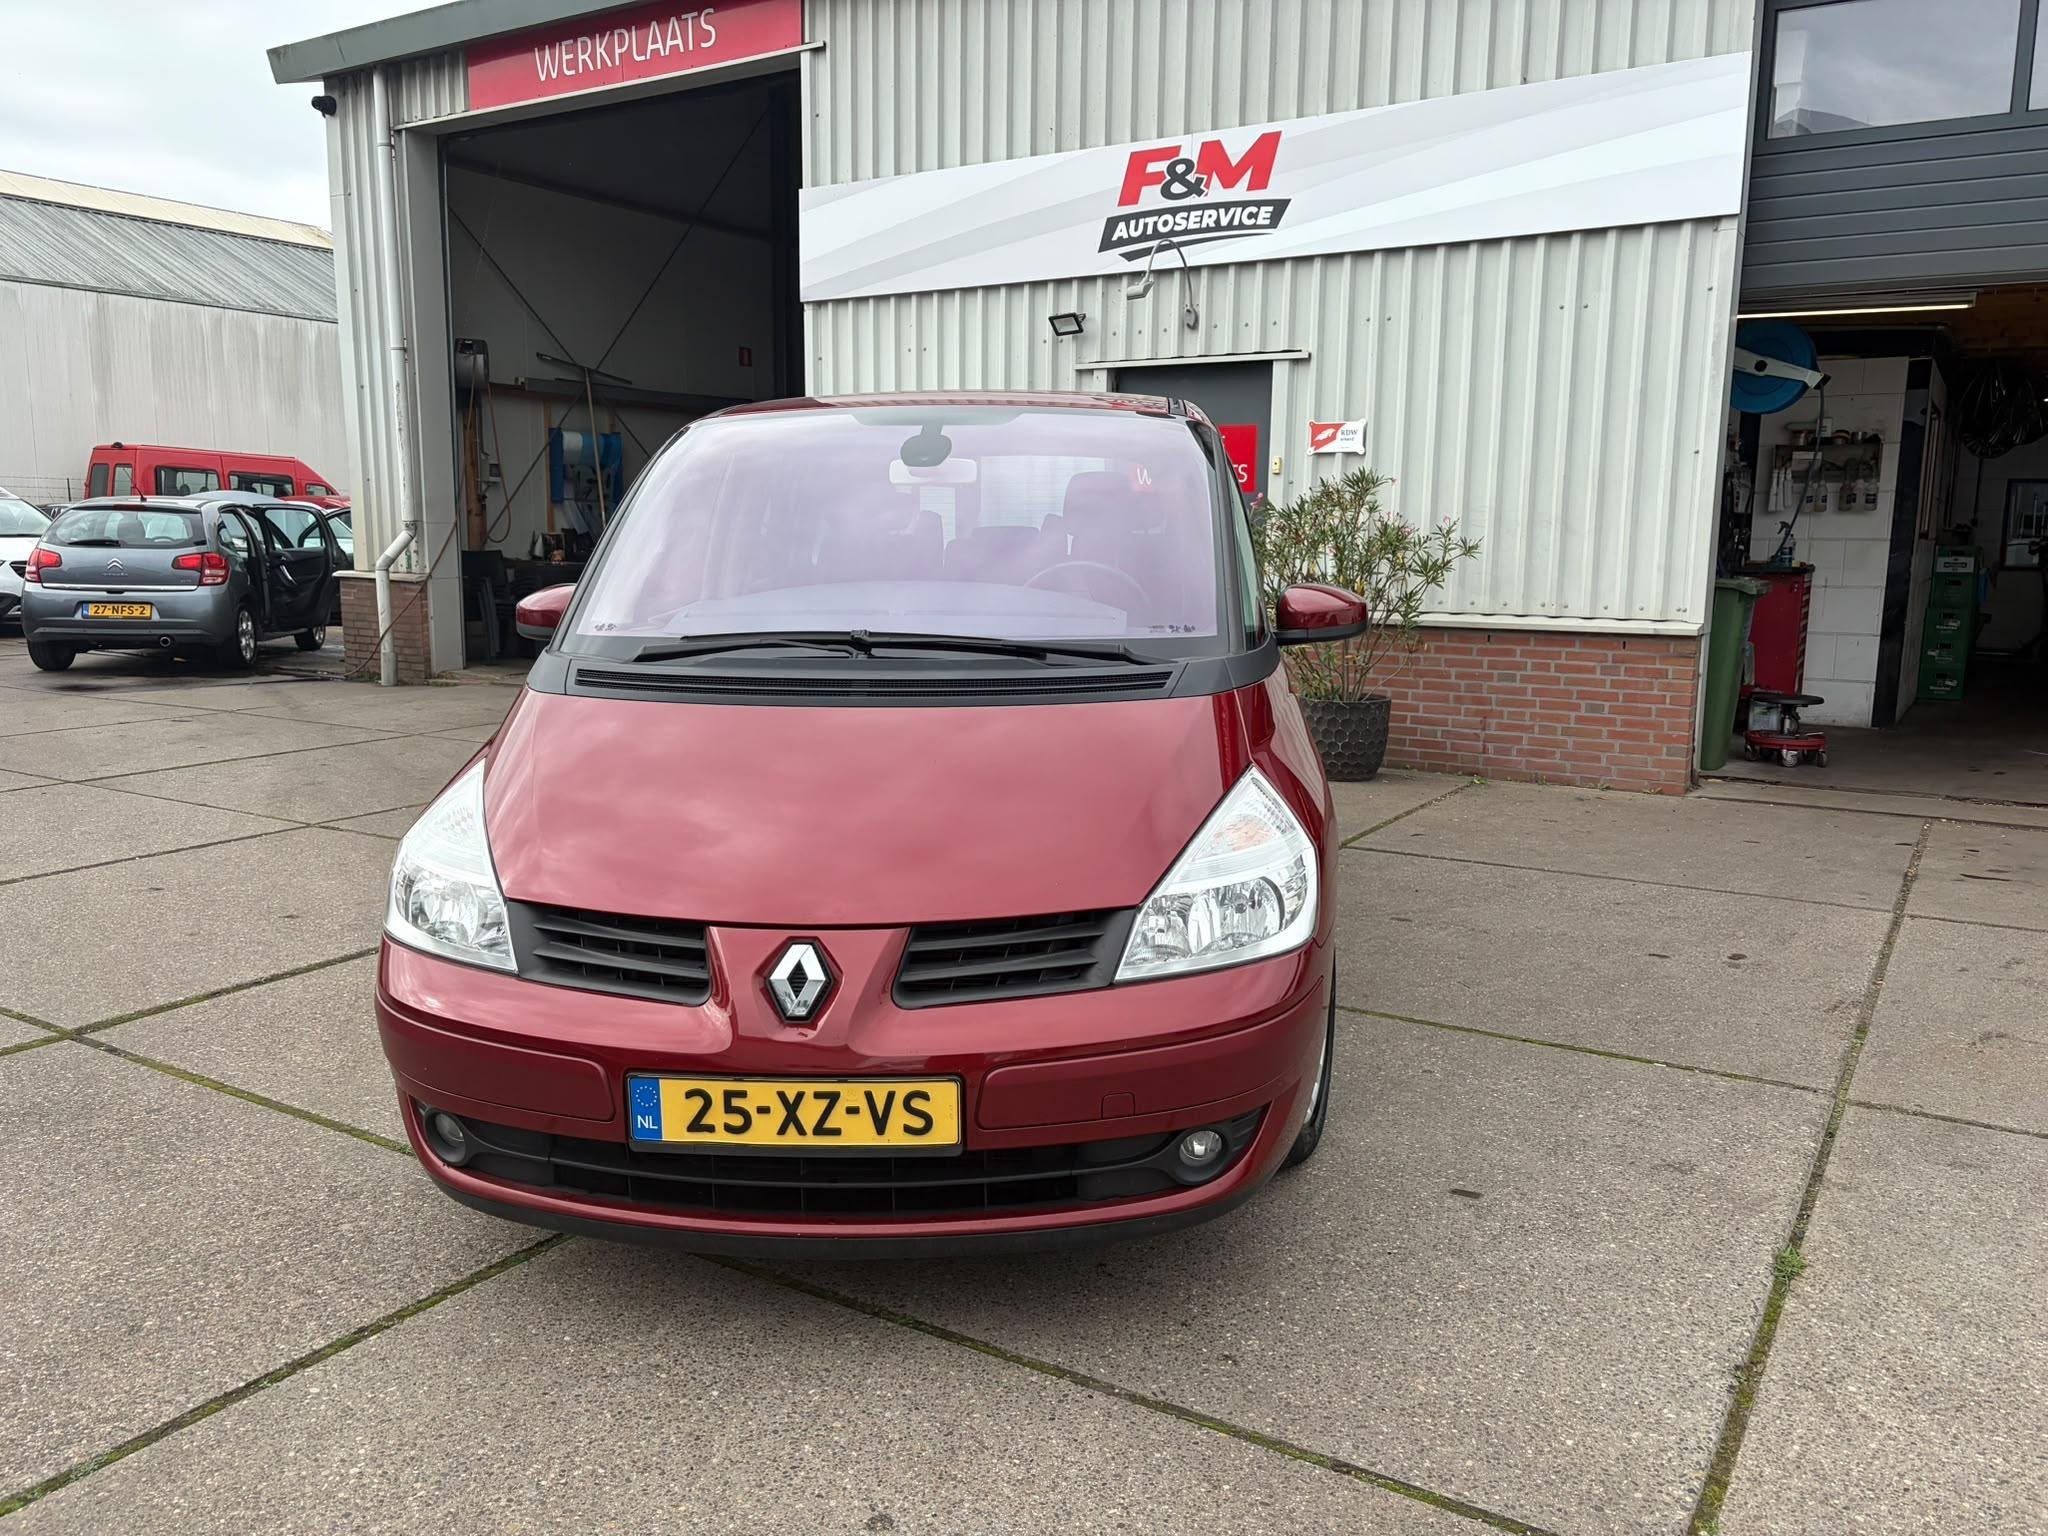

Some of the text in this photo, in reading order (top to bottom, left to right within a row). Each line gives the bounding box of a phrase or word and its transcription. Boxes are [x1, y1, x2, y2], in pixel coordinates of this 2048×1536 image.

[534, 8, 717, 82] WERKPLAATS
[1117, 131, 1282, 207] F&M
[1111, 205, 1274, 241] AUTOSERVICE
[93, 605, 146, 615] 27-NFS-2
[637, 1115, 658, 1129] NL
[684, 1088, 934, 1136] 25-XZ-VS
